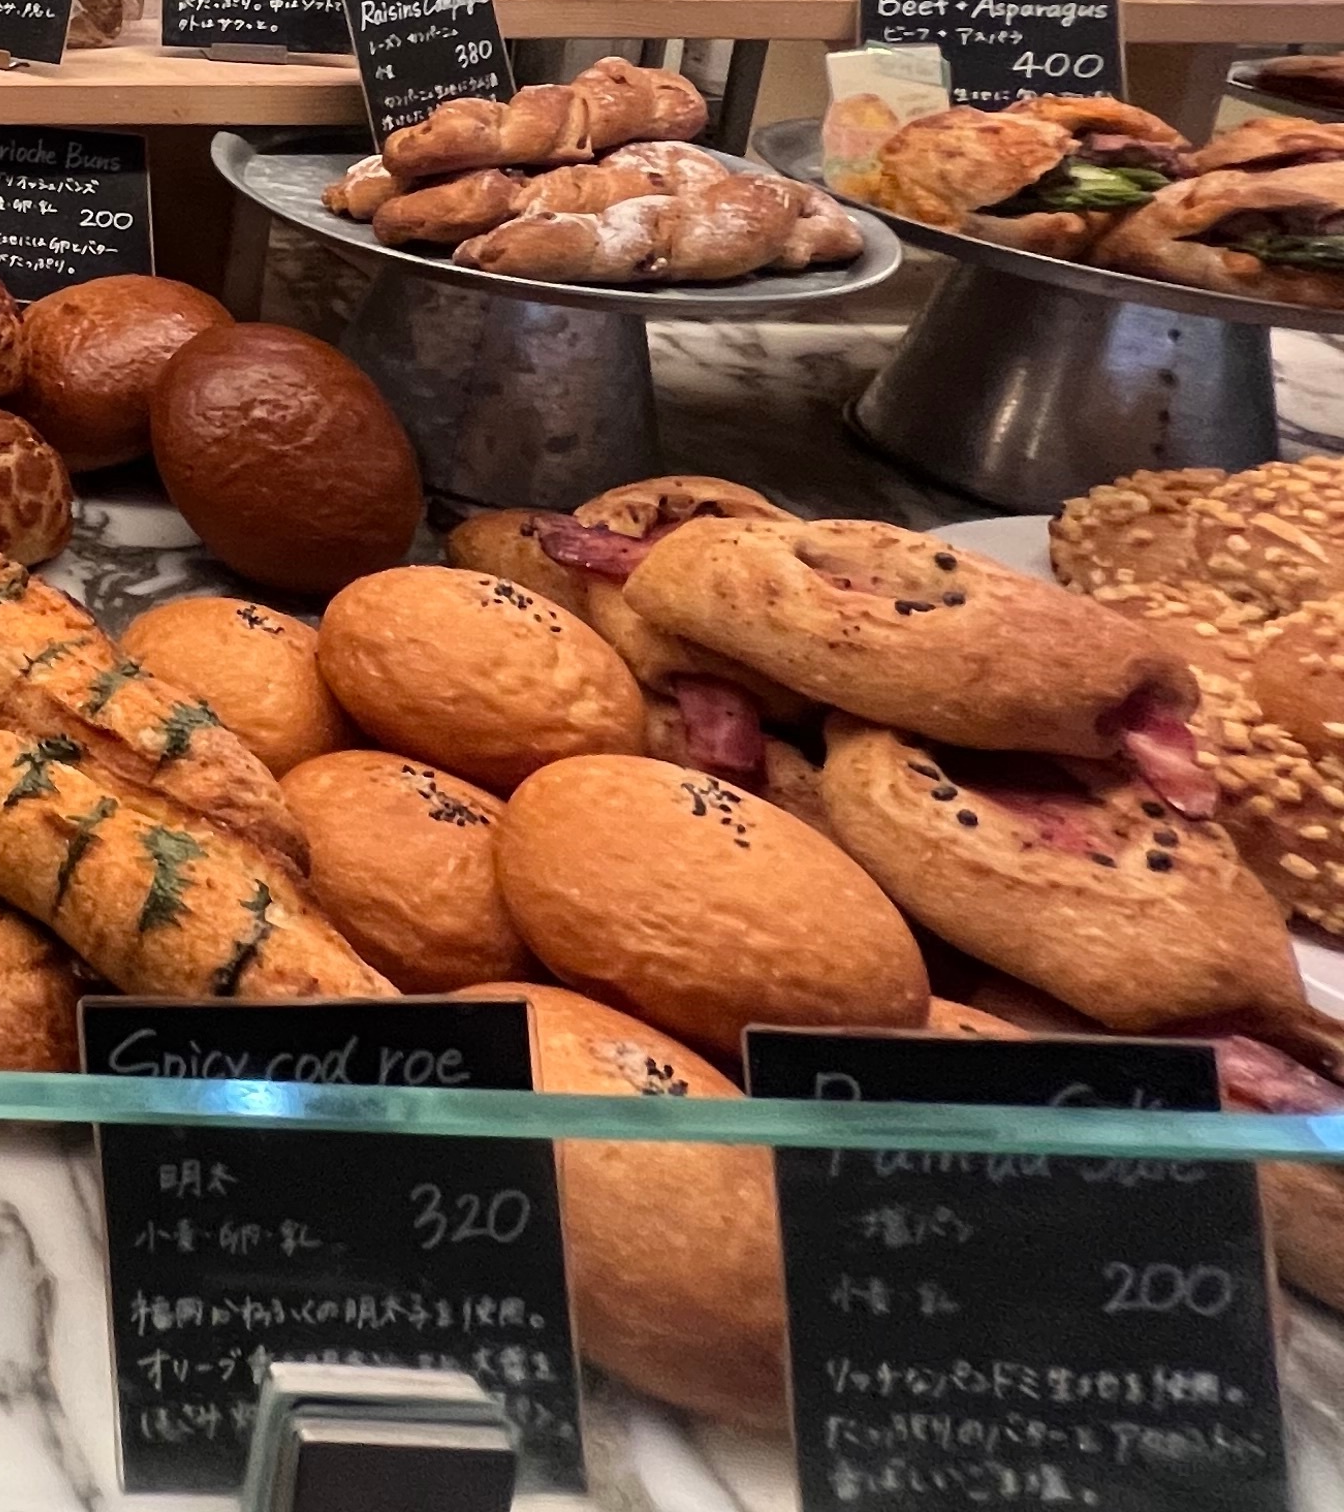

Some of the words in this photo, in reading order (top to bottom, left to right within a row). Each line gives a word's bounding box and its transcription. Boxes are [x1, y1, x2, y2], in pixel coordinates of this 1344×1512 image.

[361, 0, 422, 31] Raisins
[455, 40, 493, 68] 380
[1012, 51, 1104, 78] 400
[65, 141, 121, 171] Buns
[80, 208, 133, 230] 200
[266, 1035, 359, 1083] cod
[380, 1044, 472, 1086] roe
[410, 1182, 531, 1250] 320
[1102, 1261, 1234, 1316] 200
